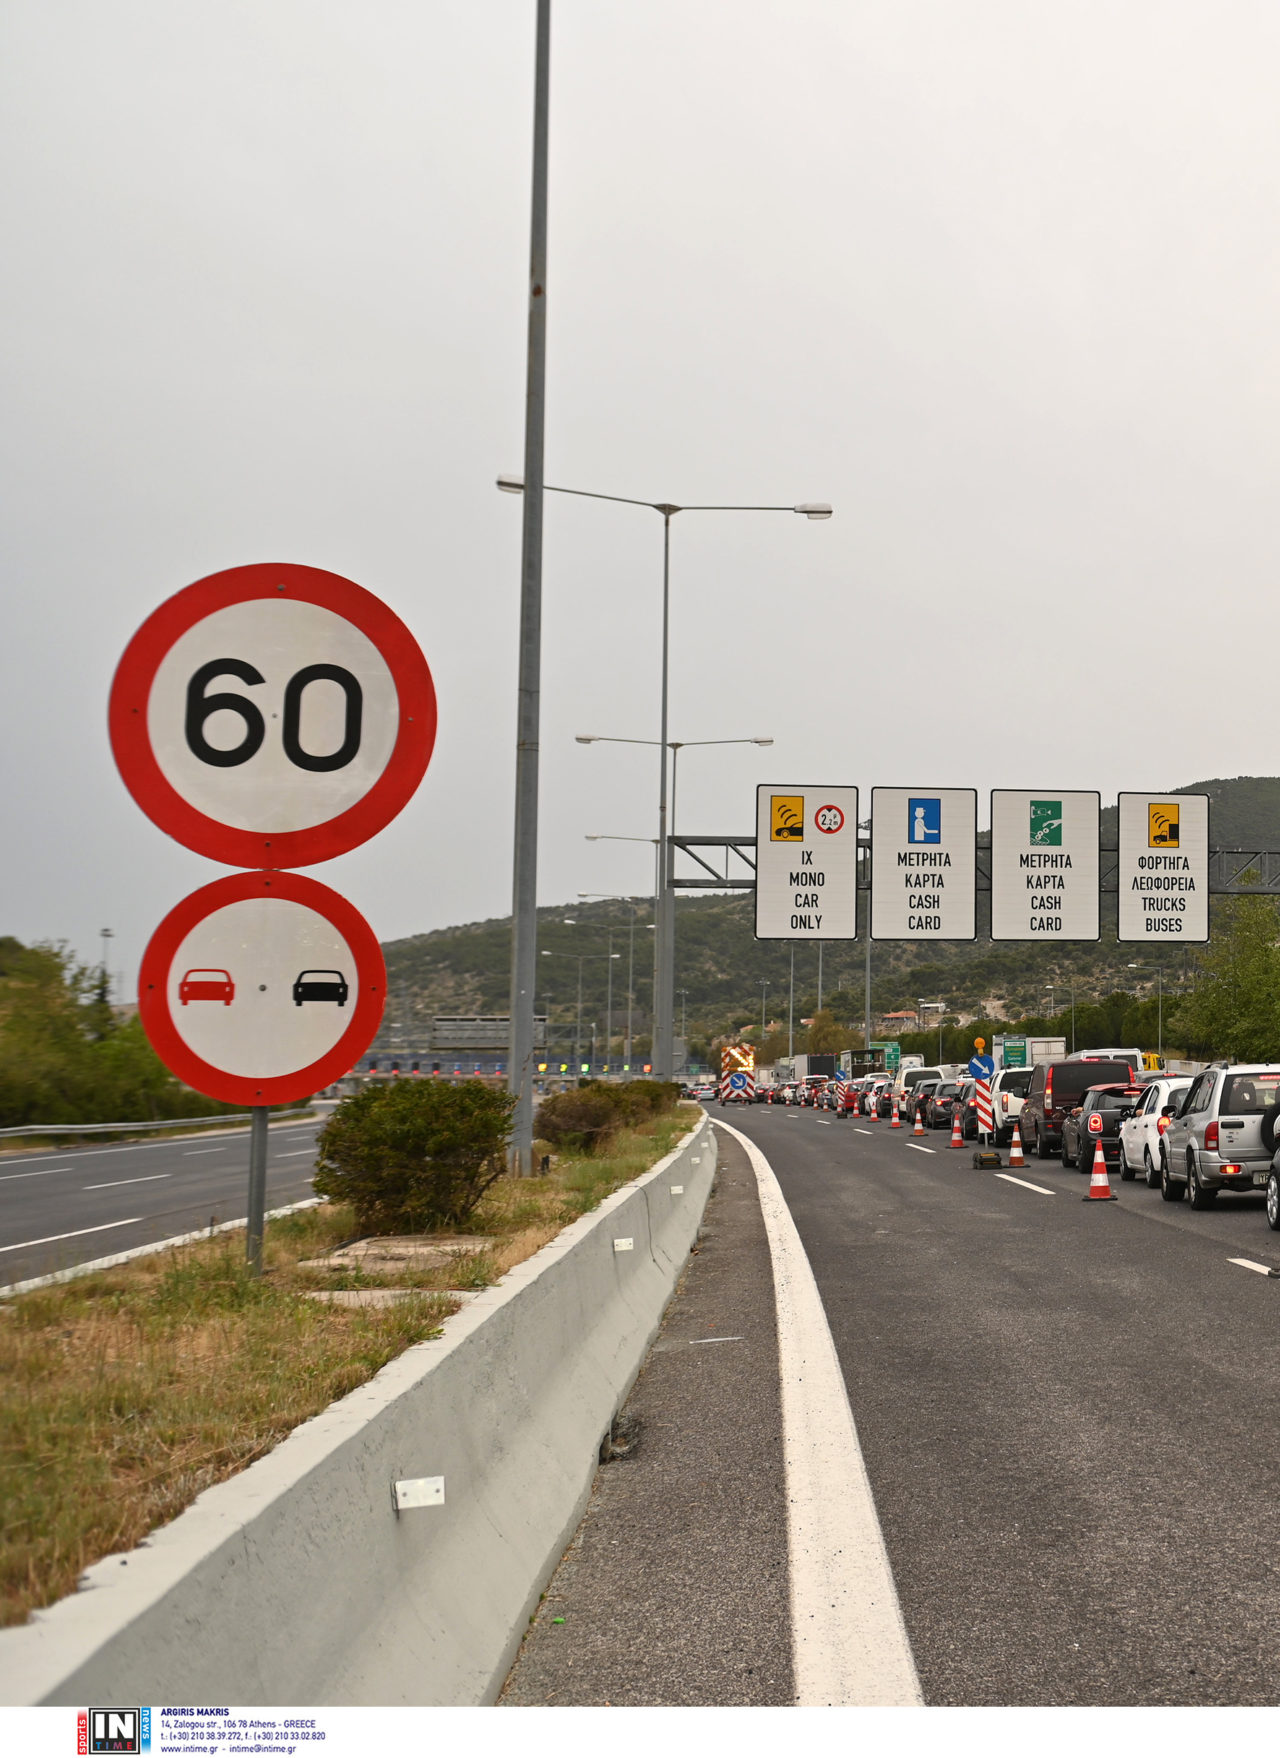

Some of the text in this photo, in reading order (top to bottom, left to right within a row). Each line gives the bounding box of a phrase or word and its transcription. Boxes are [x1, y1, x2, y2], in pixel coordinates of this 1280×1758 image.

[184, 658, 364, 773] 60
[802, 851, 812, 865] ΙΧ
[898, 853, 951, 866] ΜΕΤΡΗΤΑ
[1020, 854, 1072, 868] ΜΕΤΡΗΤΑ
[1139, 856, 1189, 870] ΦΟΡΤΗΓΑ
[790, 872, 824, 886] ΜΟΝΟ
[906, 874, 944, 888] ΚΑΡΤΑ
[1027, 875, 1064, 889] ΚΑΡΤΑ
[1132, 877, 1195, 890] ΛΕΩΦΟΡΕΙΑ
[795, 894, 818, 907] CAR
[909, 895, 939, 909] CASH
[1032, 896, 1061, 909] CASH
[1142, 897, 1185, 911] TRUCKS
[791, 915, 822, 929] ONLY
[909, 916, 940, 929] CARD
[1031, 917, 1061, 931] CARD
[1146, 918, 1182, 932] BUSES
